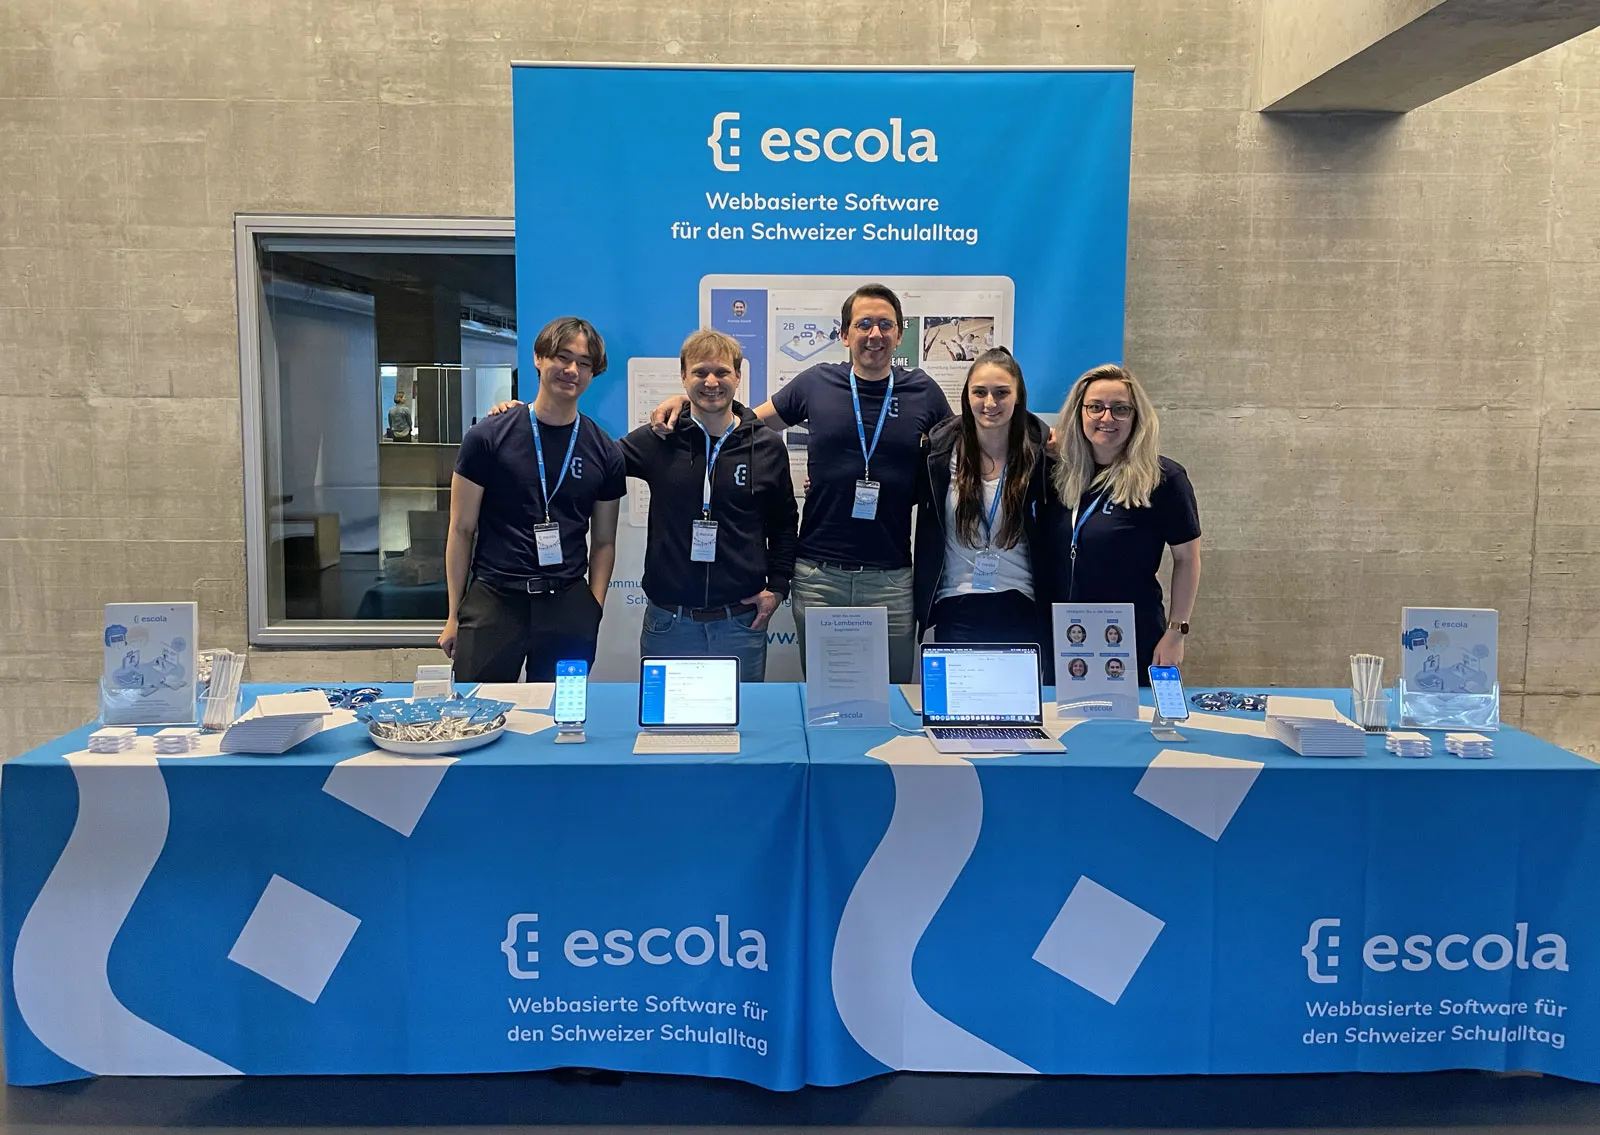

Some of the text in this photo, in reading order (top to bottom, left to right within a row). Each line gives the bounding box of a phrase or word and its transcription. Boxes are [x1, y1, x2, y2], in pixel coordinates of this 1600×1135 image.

[761, 118, 938, 163] escola
[705, 192, 939, 211] Webbasierte Software
[671, 221, 978, 246] für den Schweizer Schulalltag
[783, 322, 795, 331] 2B
[897, 357, 909, 367] ME
[141, 614, 167, 623] escola
[1441, 619, 1468, 629] escola
[840, 711, 863, 719] escola
[564, 915, 768, 971] escola
[1363, 922, 1569, 971] escola
[508, 996, 768, 1021] Webbasierte Software für
[1306, 998, 1567, 1017] Webbasierte Software für
[507, 1024, 767, 1056] den Schweizer Schulalltag
[1303, 1025, 1565, 1049] den Schweizer Schulalltag
